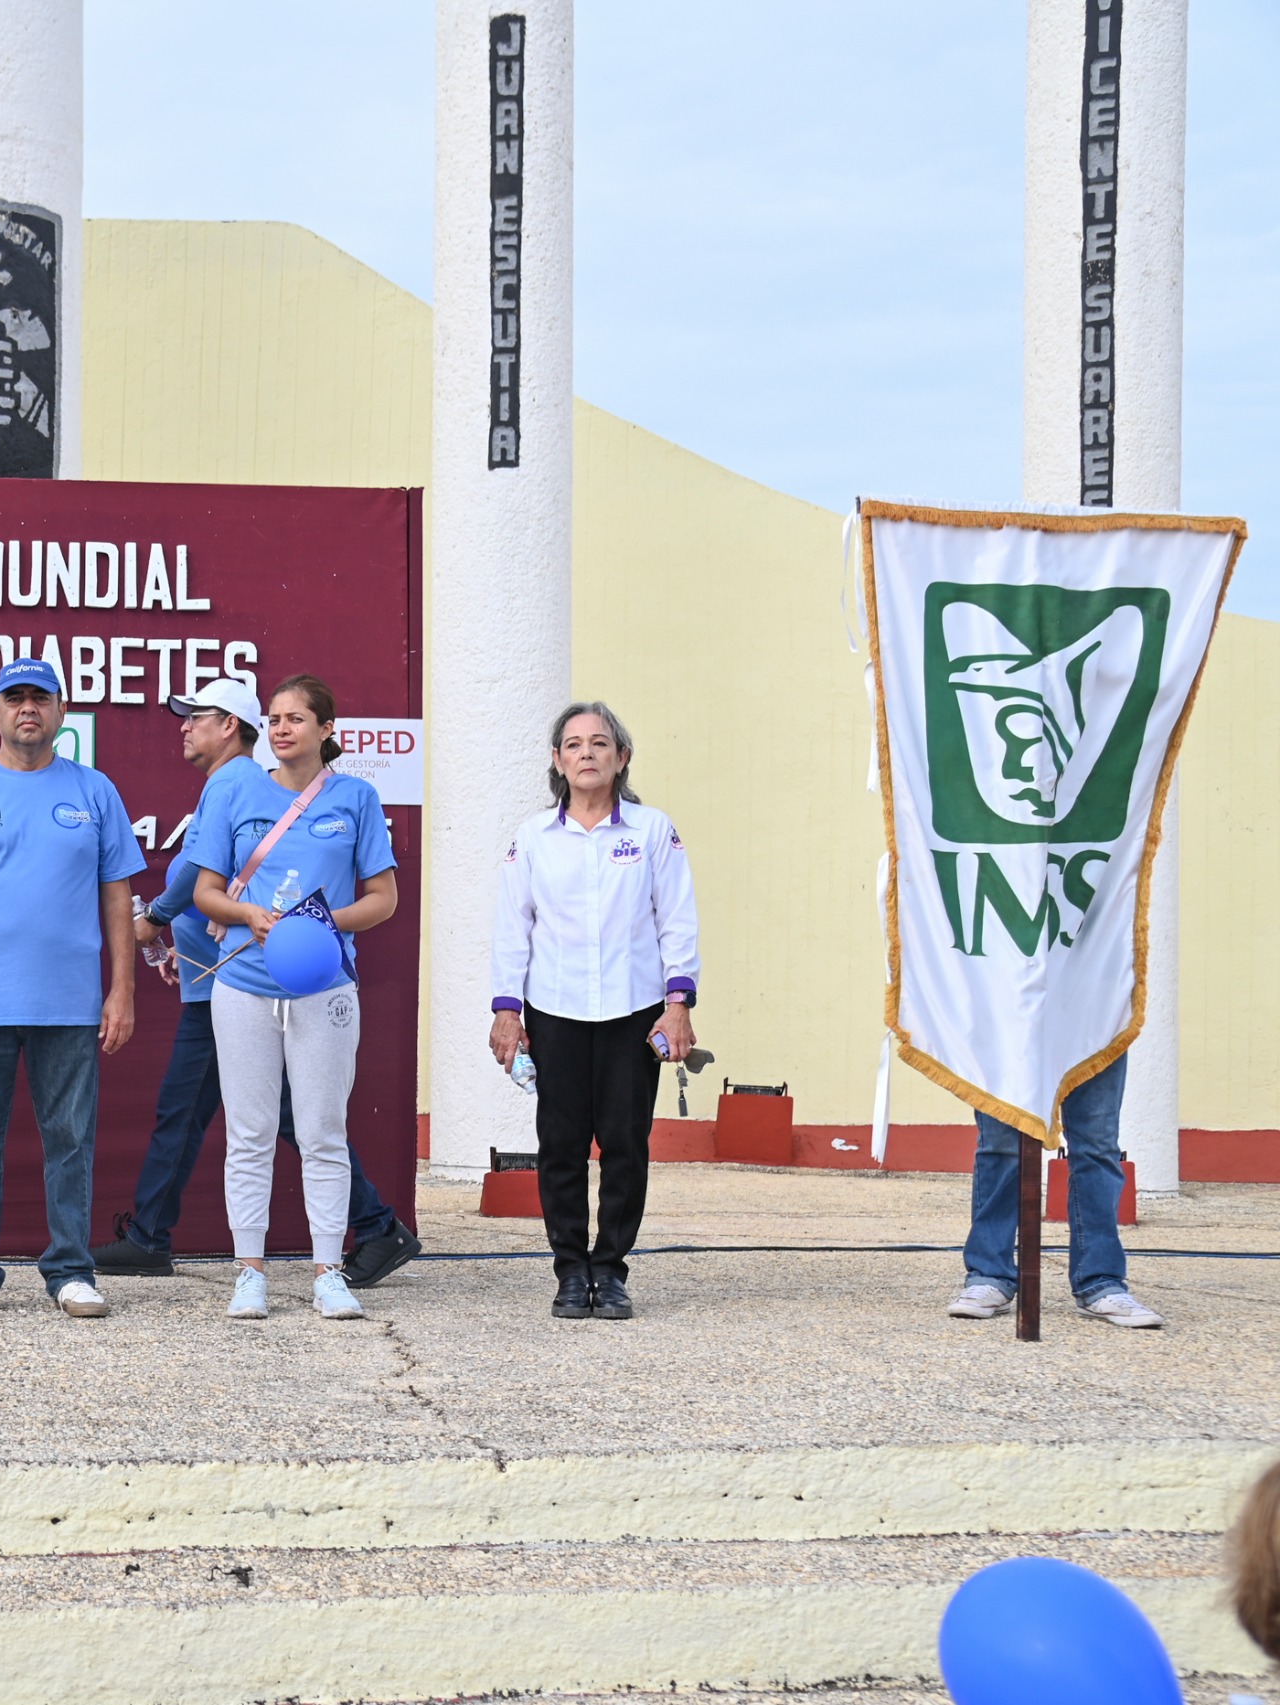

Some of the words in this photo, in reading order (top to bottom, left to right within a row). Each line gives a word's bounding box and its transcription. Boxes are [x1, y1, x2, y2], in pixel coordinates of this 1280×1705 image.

[495, 22, 521, 175] JUAN
[1085, 0, 1117, 261] ICENTE
[491, 195, 519, 462] ESCUTIA
[340, 729, 415, 755] EPED
[346, 758, 391, 768] GESTORÍA
[354, 770, 375, 779] CON
[613, 846, 640, 857] DIF
[304, 899, 324, 919] YO
[335, 1006, 348, 1016] GAP
